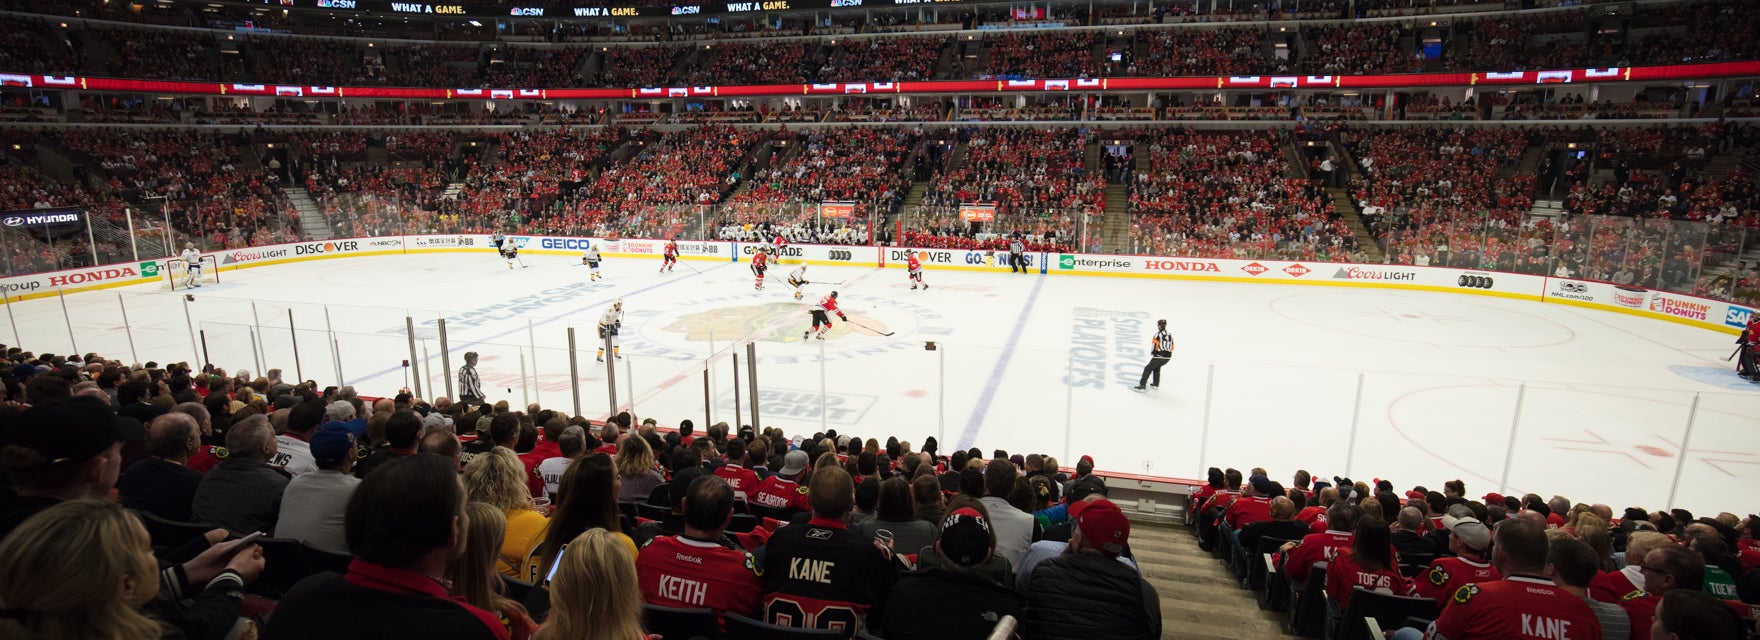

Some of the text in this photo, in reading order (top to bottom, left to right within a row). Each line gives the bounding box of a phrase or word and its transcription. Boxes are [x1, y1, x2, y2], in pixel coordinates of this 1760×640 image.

[332, 0, 356, 9] CSN
[391, 3, 466, 14] WHAT A GAME.
[682, 6, 700, 14] CSN
[727, 1, 790, 12] WHAT A GAME.
[523, 8, 544, 16] CSN
[574, 8, 639, 16] WHAT A GAME.
[26, 213, 78, 225] HYUNDAI
[295, 241, 359, 255] DISCOVER
[541, 238, 590, 250] GEICO
[233, 249, 287, 263] Coors LIGHT
[966, 252, 982, 264] GO
[1064, 257, 1131, 269] enterprise
[1144, 260, 1221, 273] HONDA
[48, 267, 138, 287] HONDA
[1347, 266, 1416, 281] Coors LIGHT
[1666, 298, 1711, 313] DUNKIN'
[1665, 306, 1707, 320] DONUTS
[676, 552, 703, 565] Reebok
[789, 557, 835, 584] KANE
[658, 573, 708, 606] KEITH
[1526, 585, 1555, 597] Reebok
[1709, 582, 1737, 597] TOEWS
[1521, 612, 1572, 640] KANE
